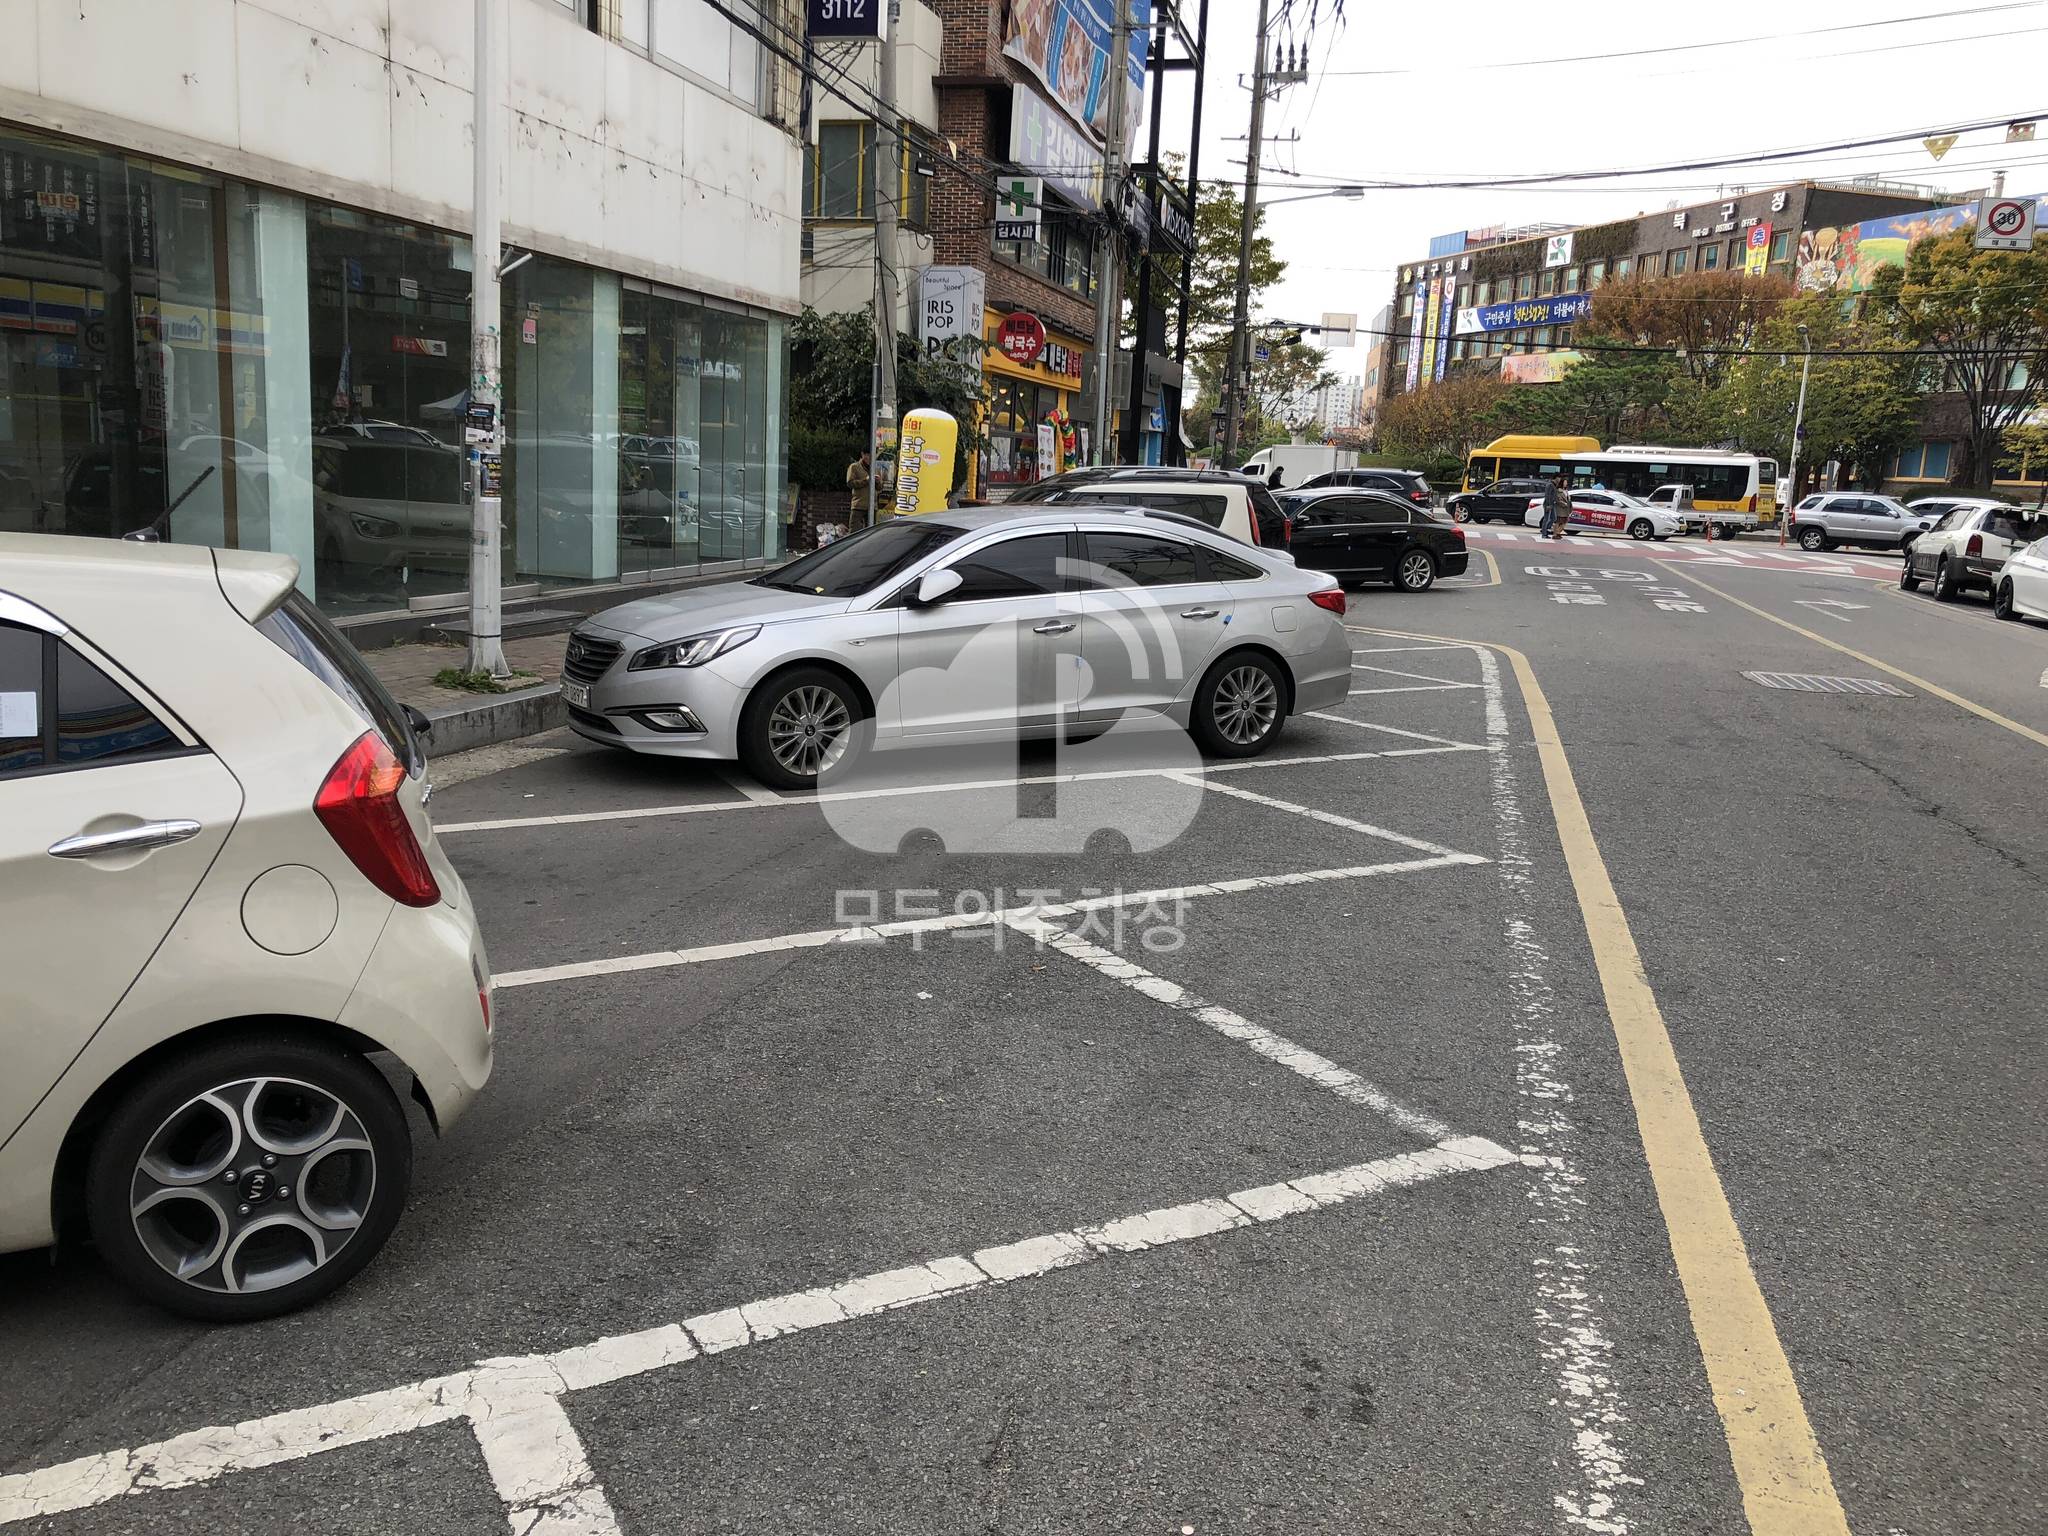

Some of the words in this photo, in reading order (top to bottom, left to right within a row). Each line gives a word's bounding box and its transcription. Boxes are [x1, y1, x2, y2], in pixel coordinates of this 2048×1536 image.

[822, 0, 865, 19] 3112
[1046, 116, 1105, 210] 김영재치
[1741, 217, 1758, 228] OFFICE
[1998, 212, 2016, 225] 30
[1416, 256, 1469, 280] 북구의회
[927, 300, 954, 314] IRIS
[1554, 301, 1576, 318] 더불어
[927, 315, 954, 329] POP
[1005, 320, 1036, 334] 베트남
[1004, 335, 1036, 351] 쌀국수
